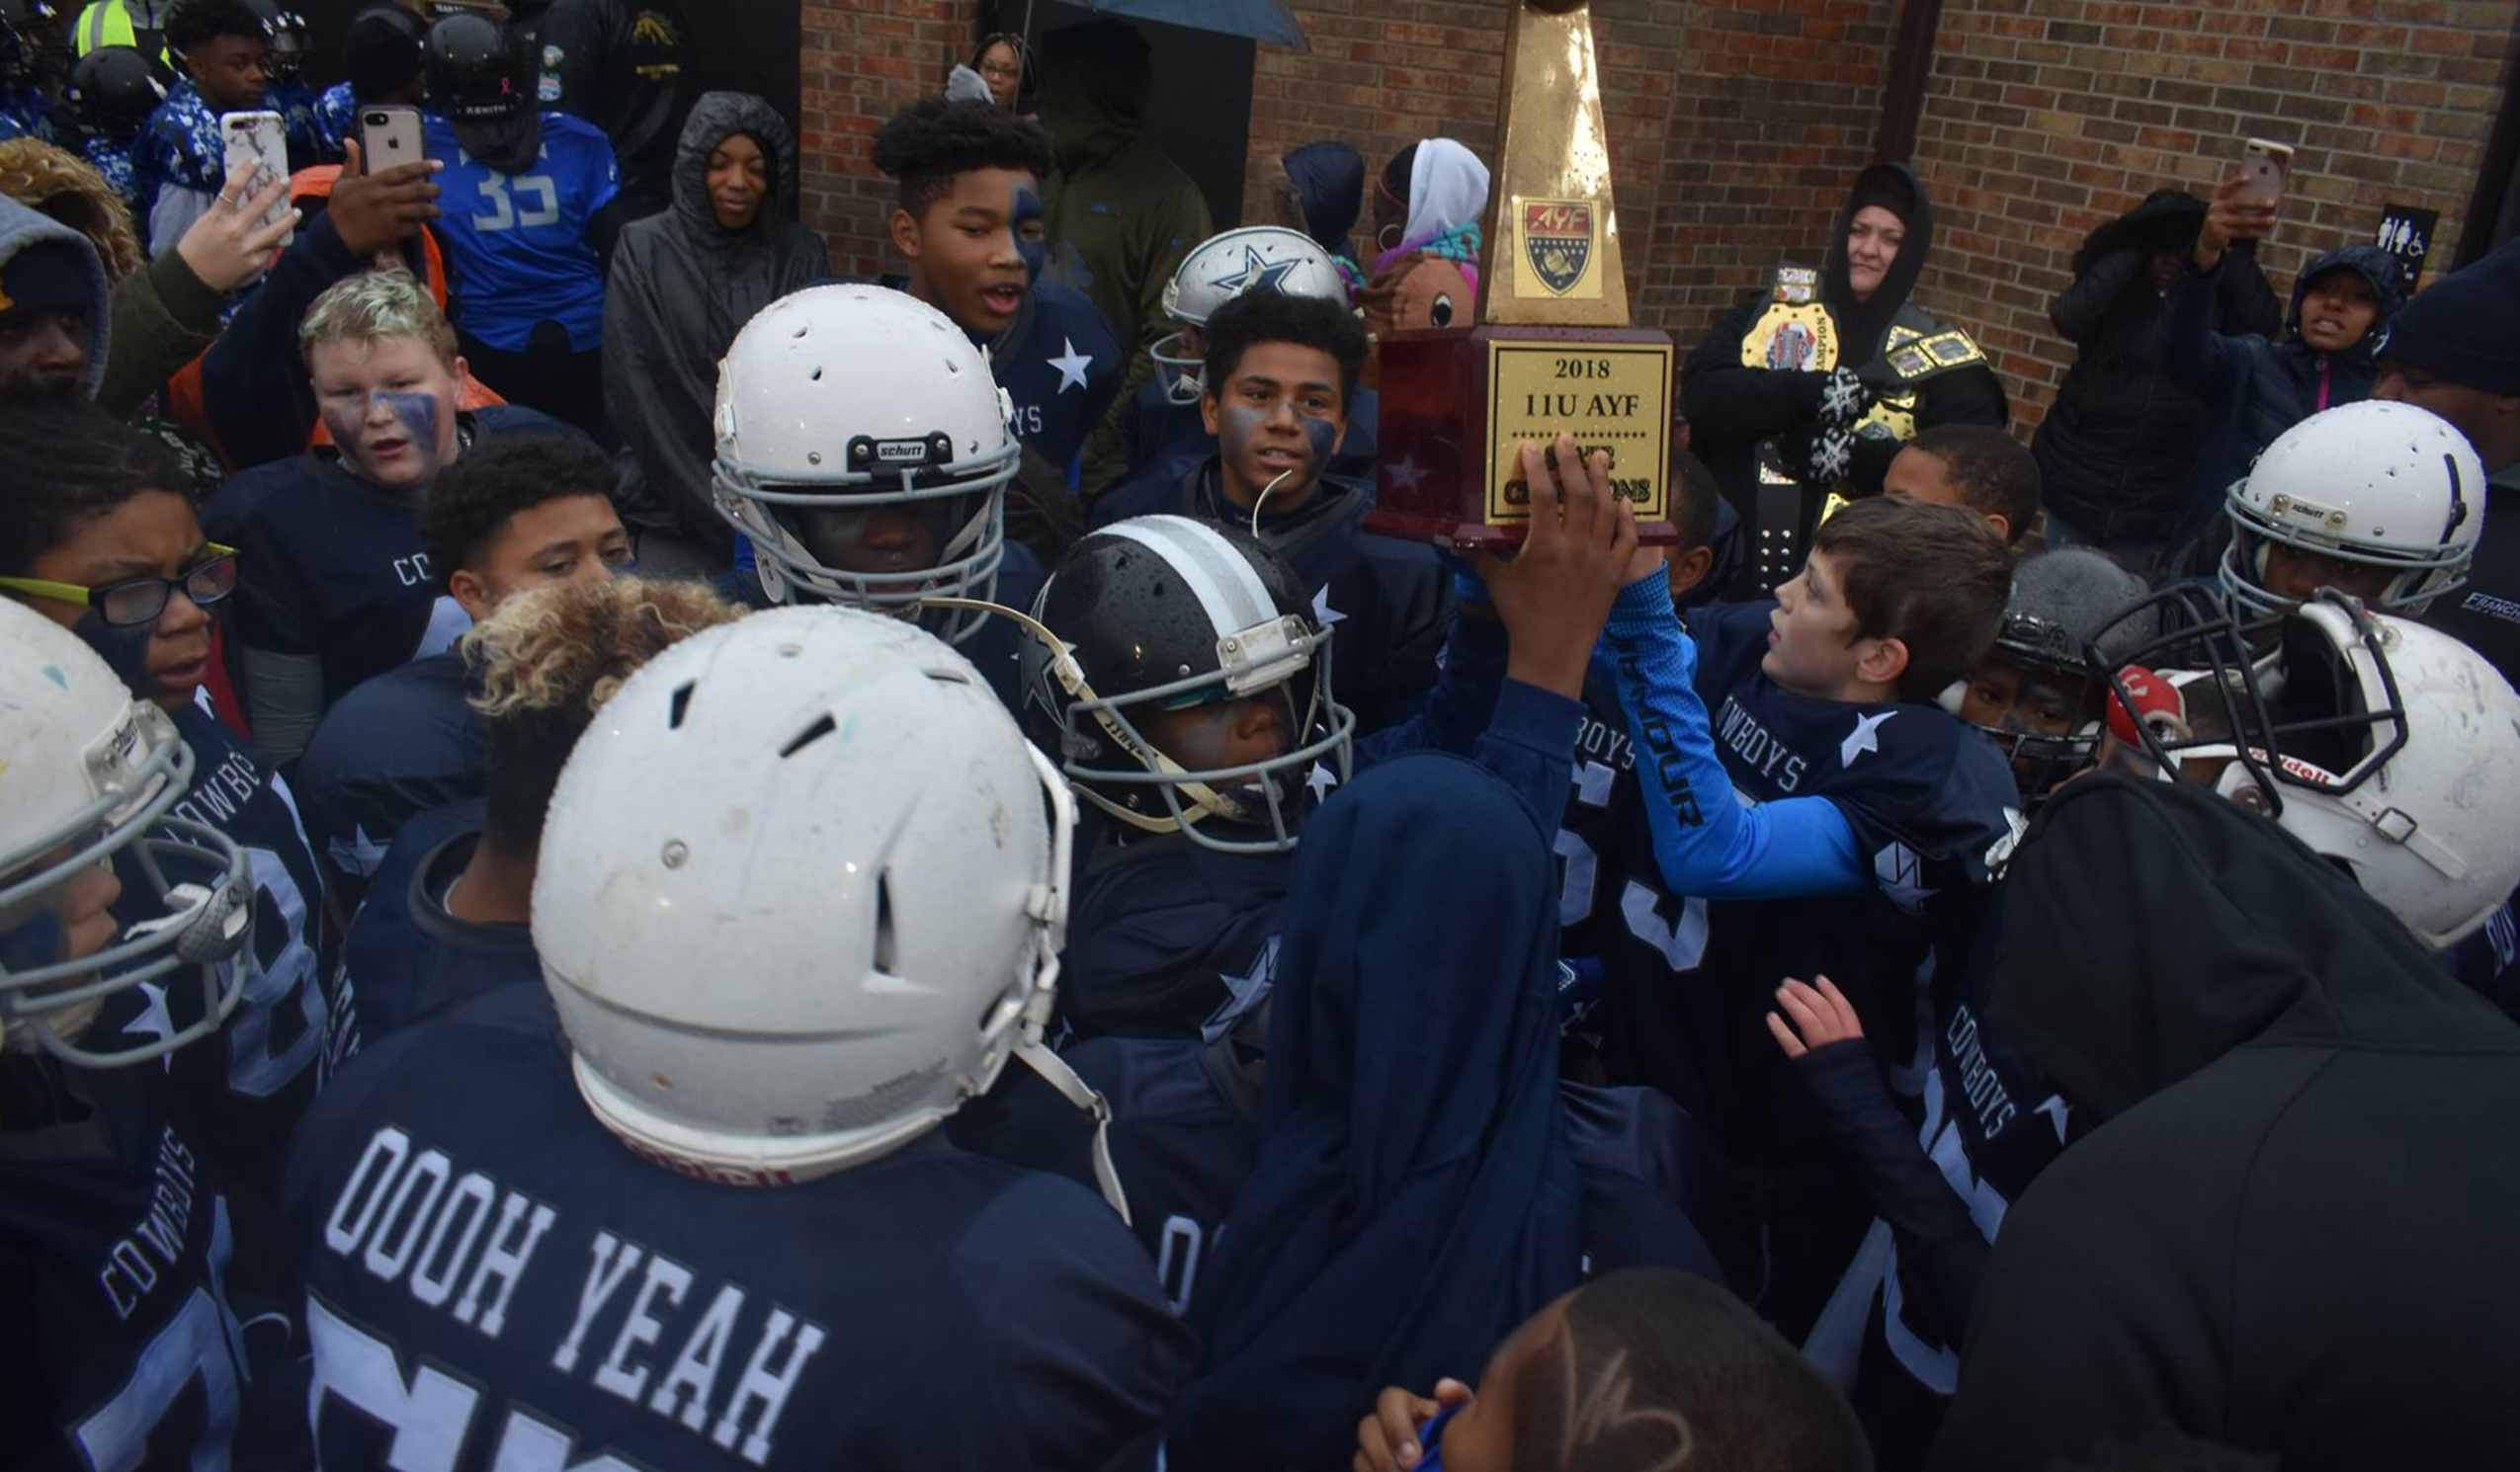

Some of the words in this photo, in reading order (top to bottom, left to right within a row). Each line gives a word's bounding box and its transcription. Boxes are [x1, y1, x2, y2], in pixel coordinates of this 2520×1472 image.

[1530, 206, 1587, 230] AYF
[1814, 316, 1827, 371] AMPION
[1554, 359, 1610, 379] 2018
[1525, 393, 1578, 417] 11U
[1585, 394, 1639, 417] AYF
[880, 445, 923, 457] schutt
[2292, 503, 2324, 519] schutt
[1946, 1003, 2017, 1140] COWBOYS
[325, 1126, 557, 1339] OOOH
[551, 1230, 827, 1468] YEAH
